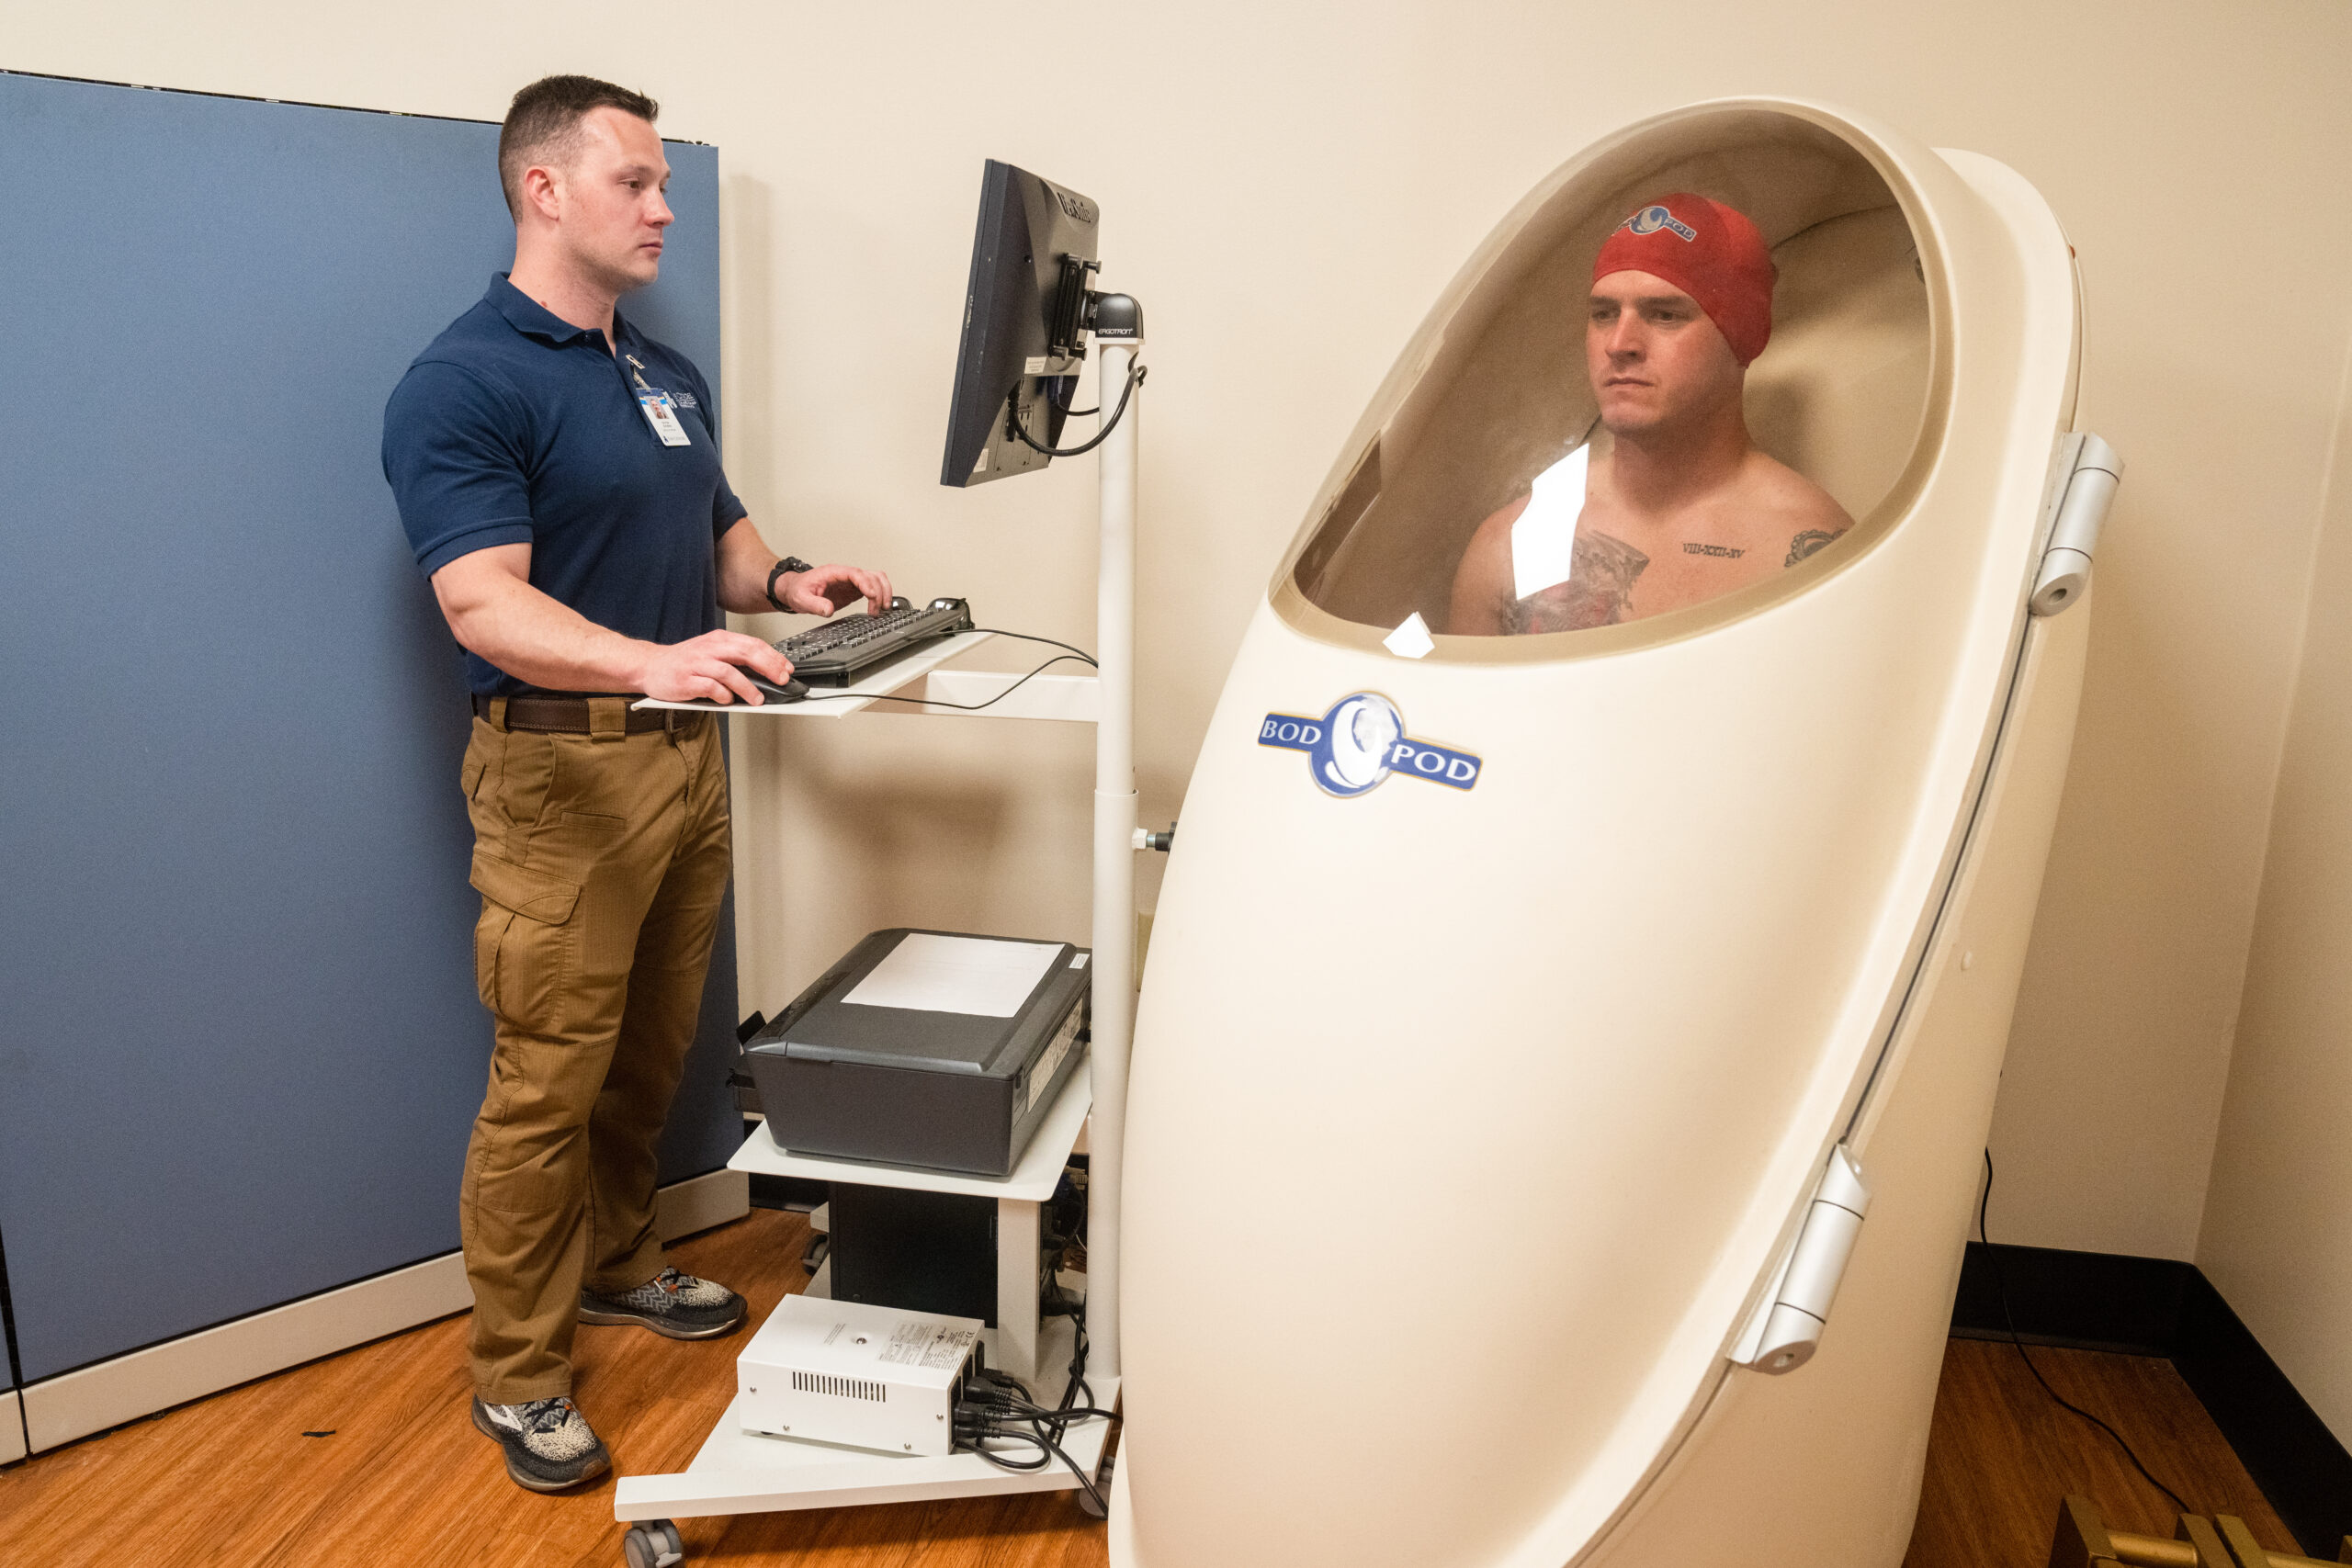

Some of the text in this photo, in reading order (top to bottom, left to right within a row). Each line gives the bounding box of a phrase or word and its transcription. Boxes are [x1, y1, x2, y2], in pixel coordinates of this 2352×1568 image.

[1665, 218, 1693, 238] POD
[1261, 720, 1476, 781] BOD POD
